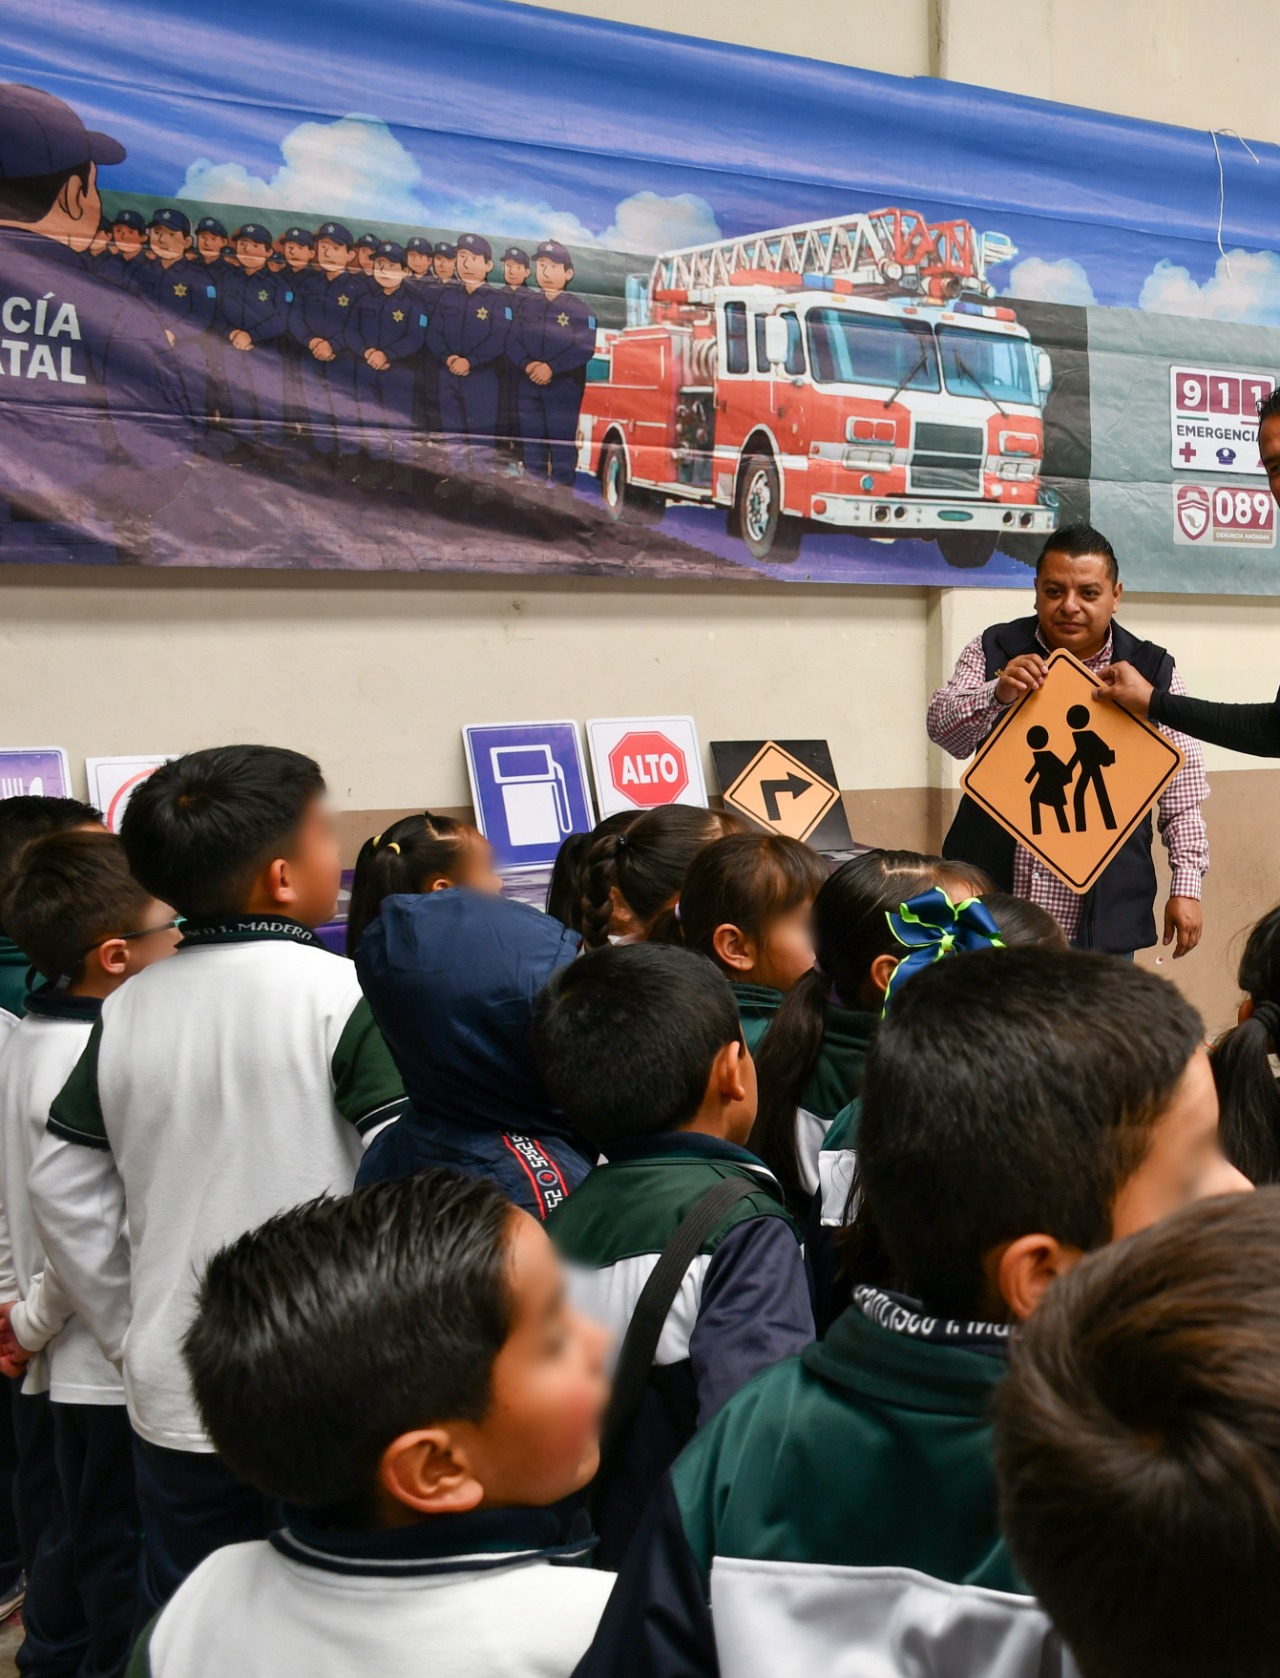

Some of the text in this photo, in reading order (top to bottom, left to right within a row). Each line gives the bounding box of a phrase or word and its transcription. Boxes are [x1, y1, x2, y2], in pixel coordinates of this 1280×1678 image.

[2, 291, 82, 340] CÍA
[0, 338, 87, 384] TAL
[1183, 379, 1262, 412] 911
[1215, 489, 1270, 526] 089
[621, 752, 679, 785] ALTO
